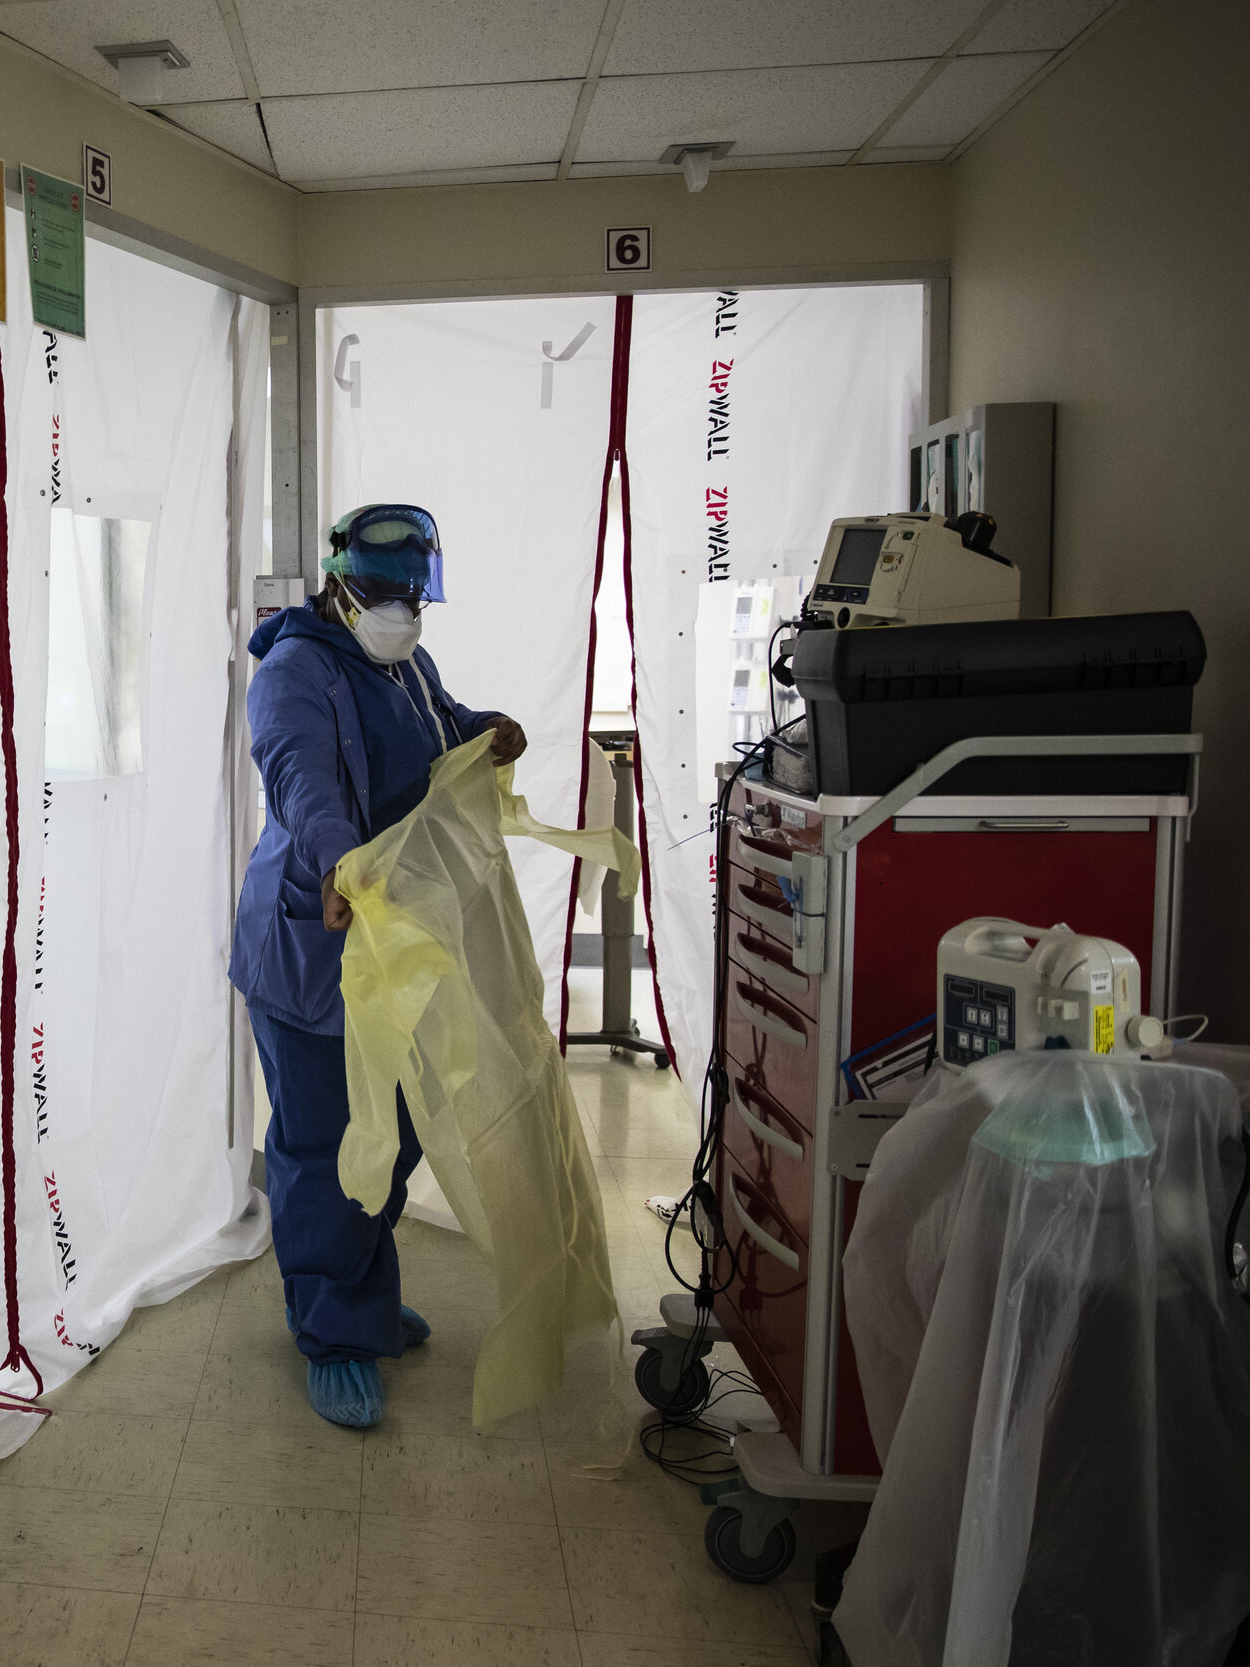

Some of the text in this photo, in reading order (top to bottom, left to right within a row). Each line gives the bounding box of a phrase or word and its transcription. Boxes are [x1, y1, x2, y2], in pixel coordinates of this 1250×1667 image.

[91, 156, 106, 194] 5
[615, 234, 641, 265] 6
[707, 357, 735, 462] ZIPWALL
[30, 1021, 50, 1145] ZIPWALL
[44, 1170, 78, 1292] ZIPWALL
